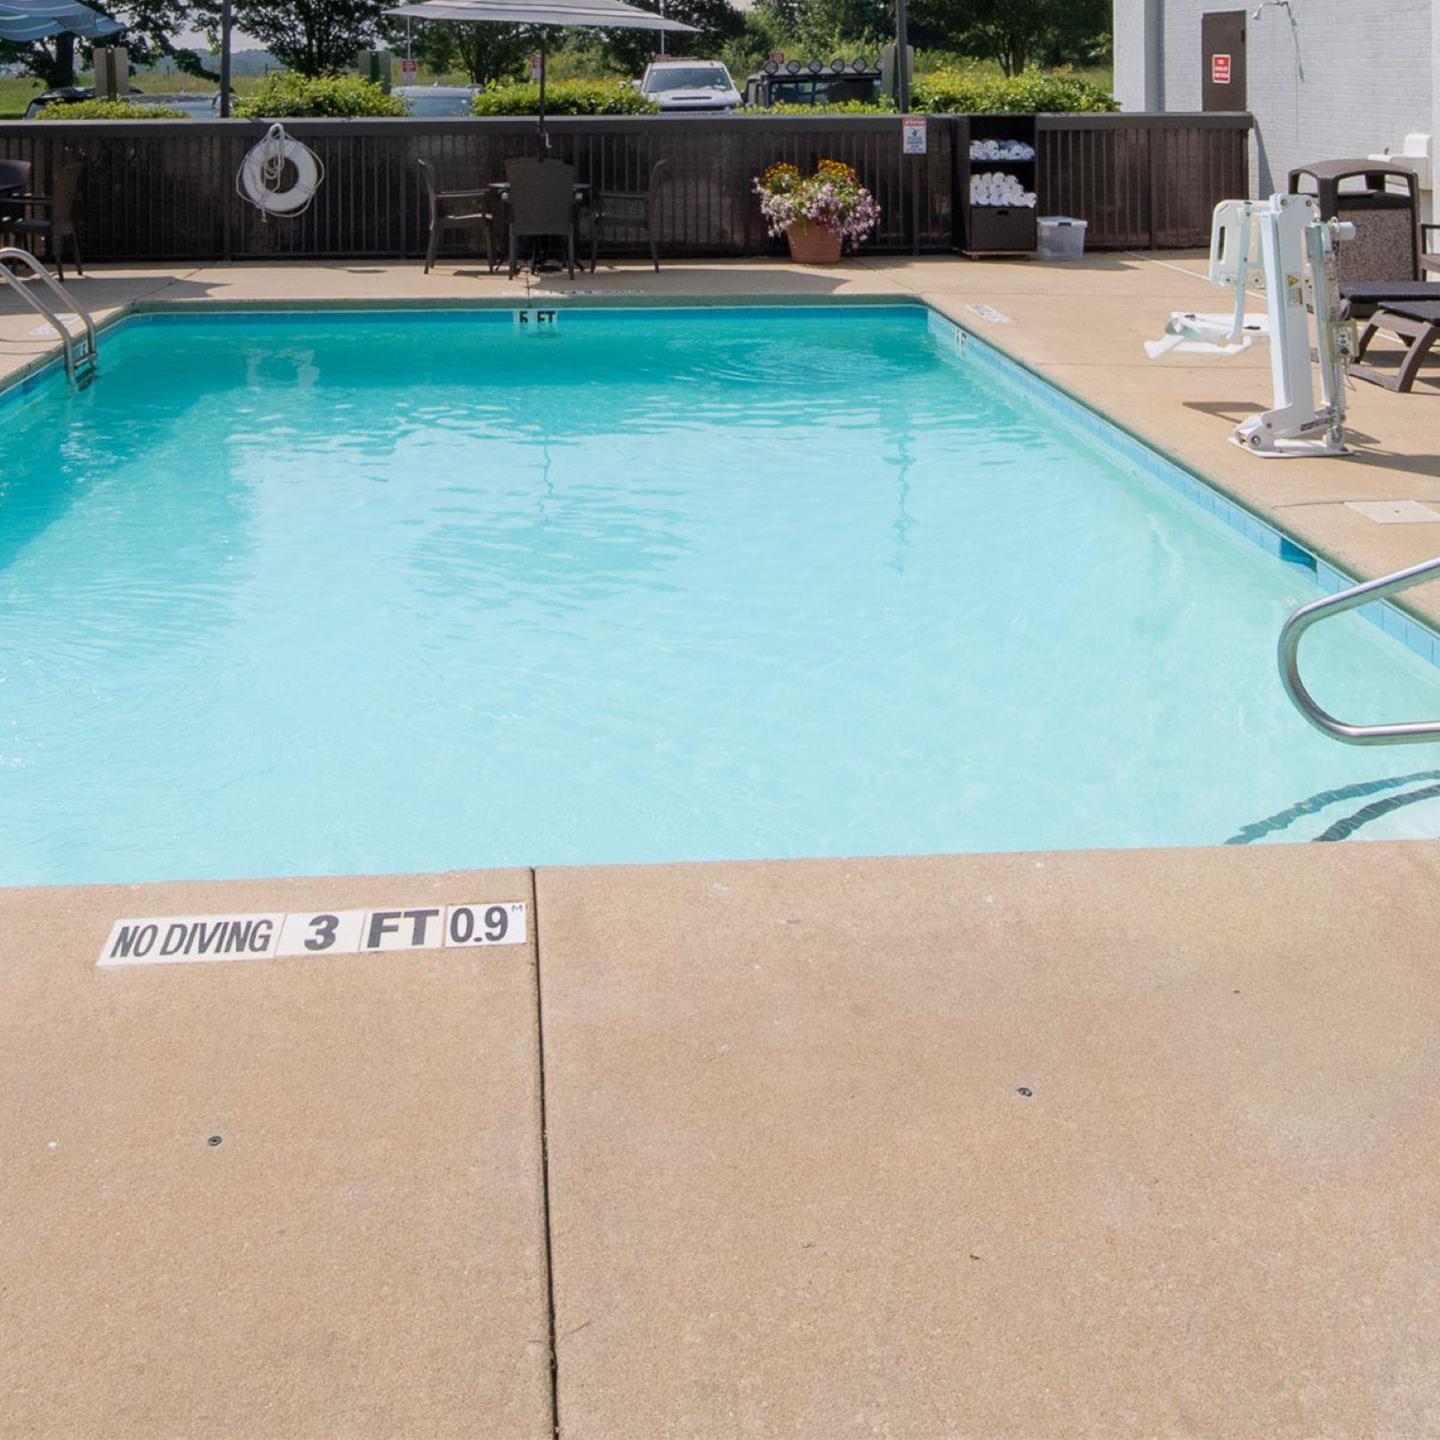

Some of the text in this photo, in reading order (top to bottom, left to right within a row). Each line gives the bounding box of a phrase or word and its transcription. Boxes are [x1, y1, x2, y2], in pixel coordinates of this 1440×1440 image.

[110, 924, 158, 958] NO
[159, 919, 274, 956] DIVING
[304, 914, 340, 952] 3
[366, 909, 440, 949] FT
[449, 905, 509, 943] 0.9
